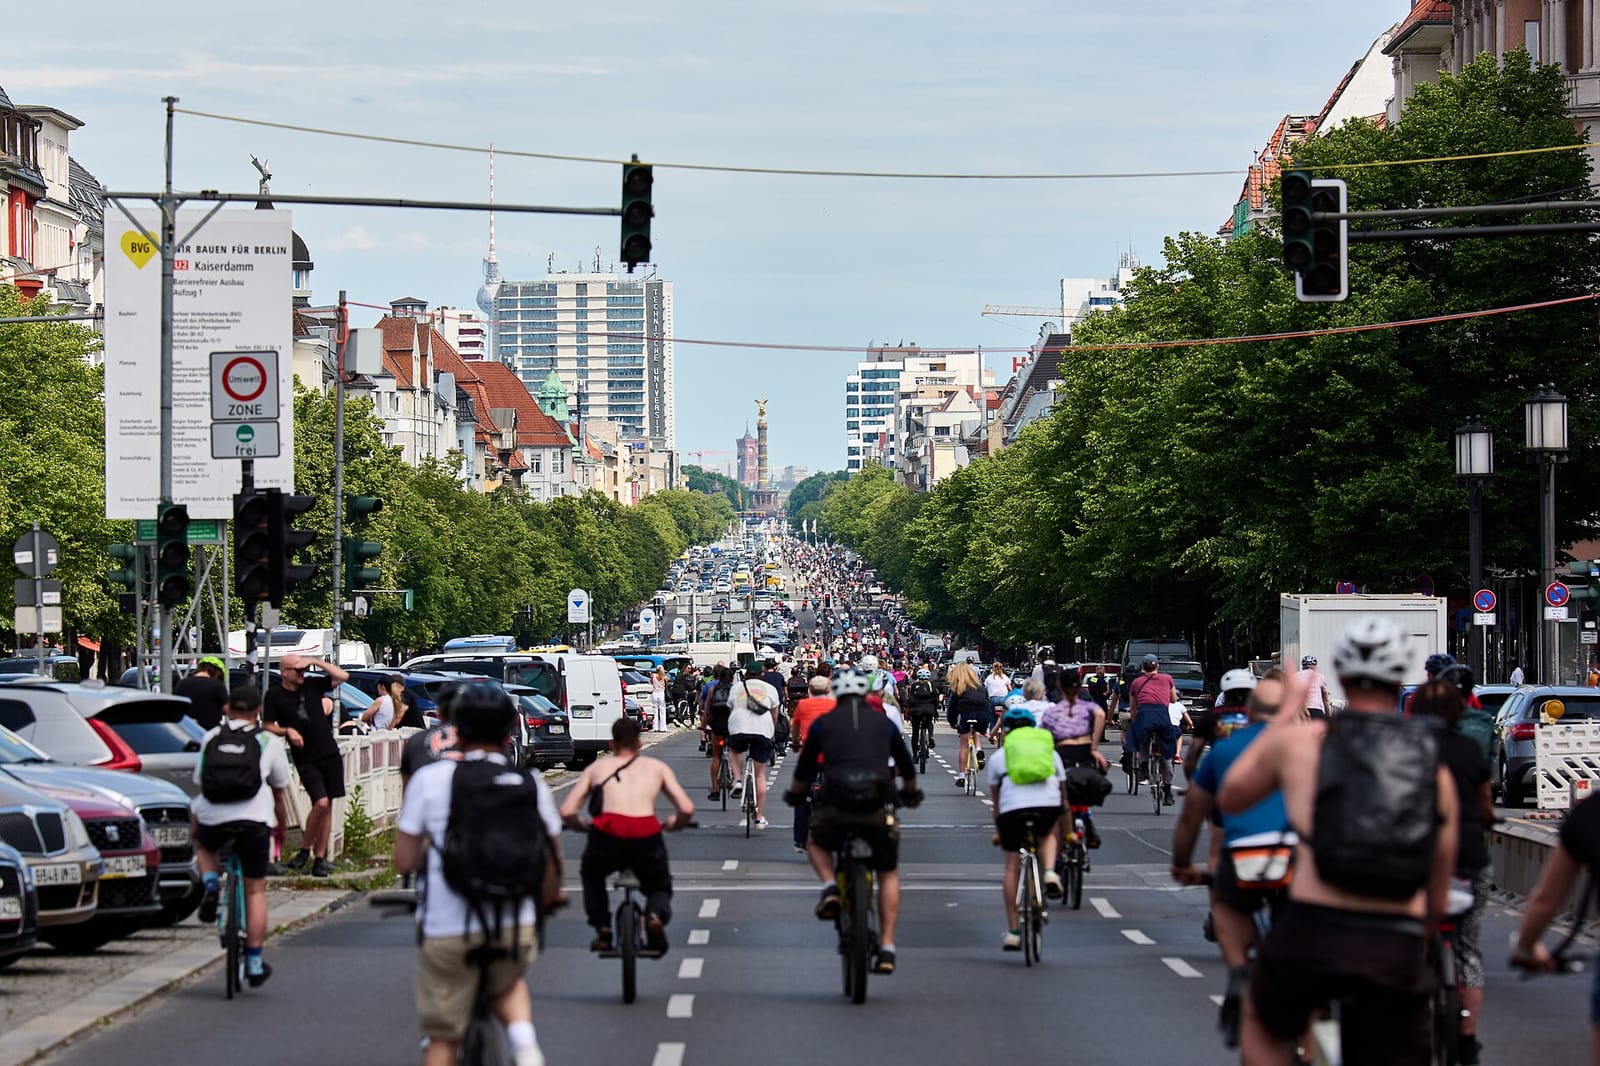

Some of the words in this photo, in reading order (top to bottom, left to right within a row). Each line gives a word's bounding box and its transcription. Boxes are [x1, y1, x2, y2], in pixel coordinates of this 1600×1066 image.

[131, 242, 150, 253] BVG
[196, 245, 227, 254] BAUEN
[232, 244, 249, 255] FÜR
[254, 246, 287, 255] BERLIN
[174, 260, 188, 270] U2
[195, 261, 254, 272] Kaiserdamm
[173, 278, 218, 286] Barrierefreier
[219, 278, 245, 287] Ausbau
[173, 288, 197, 298] Aufzug
[228, 375, 260, 384] Umwelt
[653, 368, 661, 437] UNIVERSIT
[228, 404, 262, 416] ZONE
[235, 445, 257, 456] frei
